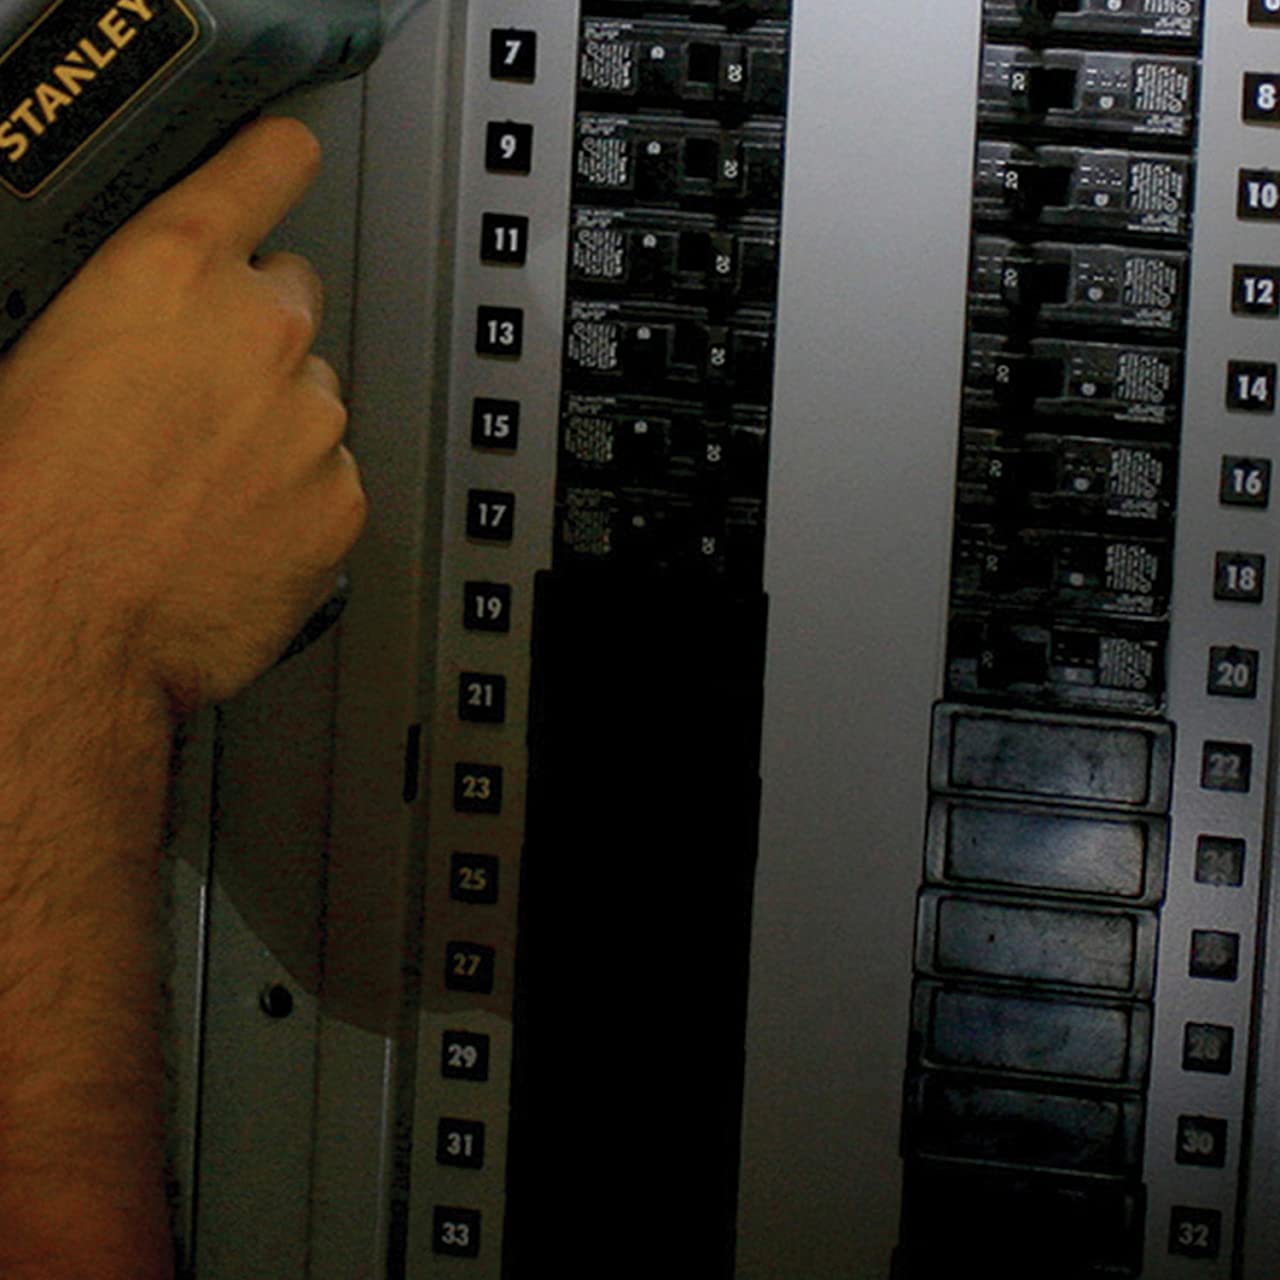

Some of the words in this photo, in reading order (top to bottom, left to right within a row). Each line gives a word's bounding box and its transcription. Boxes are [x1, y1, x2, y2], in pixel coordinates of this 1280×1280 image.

[504, 40, 521, 64] 7
[1257, 83, 1276, 109] 8
[501, 134, 516, 158] 9
[1248, 182, 1278, 208] 10
[495, 228, 518, 252] 11
[1244, 278, 1274, 304] 12
[488, 320, 514, 345] 13
[1238, 375, 1267, 401] 14
[483, 413, 509, 437] 15
[1233, 469, 1261, 495] 16
[479, 503, 506, 527] 17
[1227, 565, 1256, 590] 18
[476, 596, 502, 619] 19
[1216, 661, 1249, 687] 20
[468, 683, 492, 706] 21
[1210, 753, 1240, 778] 22
[463, 775, 490, 799] 23
[459, 867, 487, 890] 25
[454, 953, 481, 976] 27
[448, 1044, 477, 1067] 29
[447, 1132, 473, 1156] 31
[1183, 1129, 1213, 1154] 30
[442, 1222, 469, 1246] 33
[1179, 1222, 1208, 1247] 32
